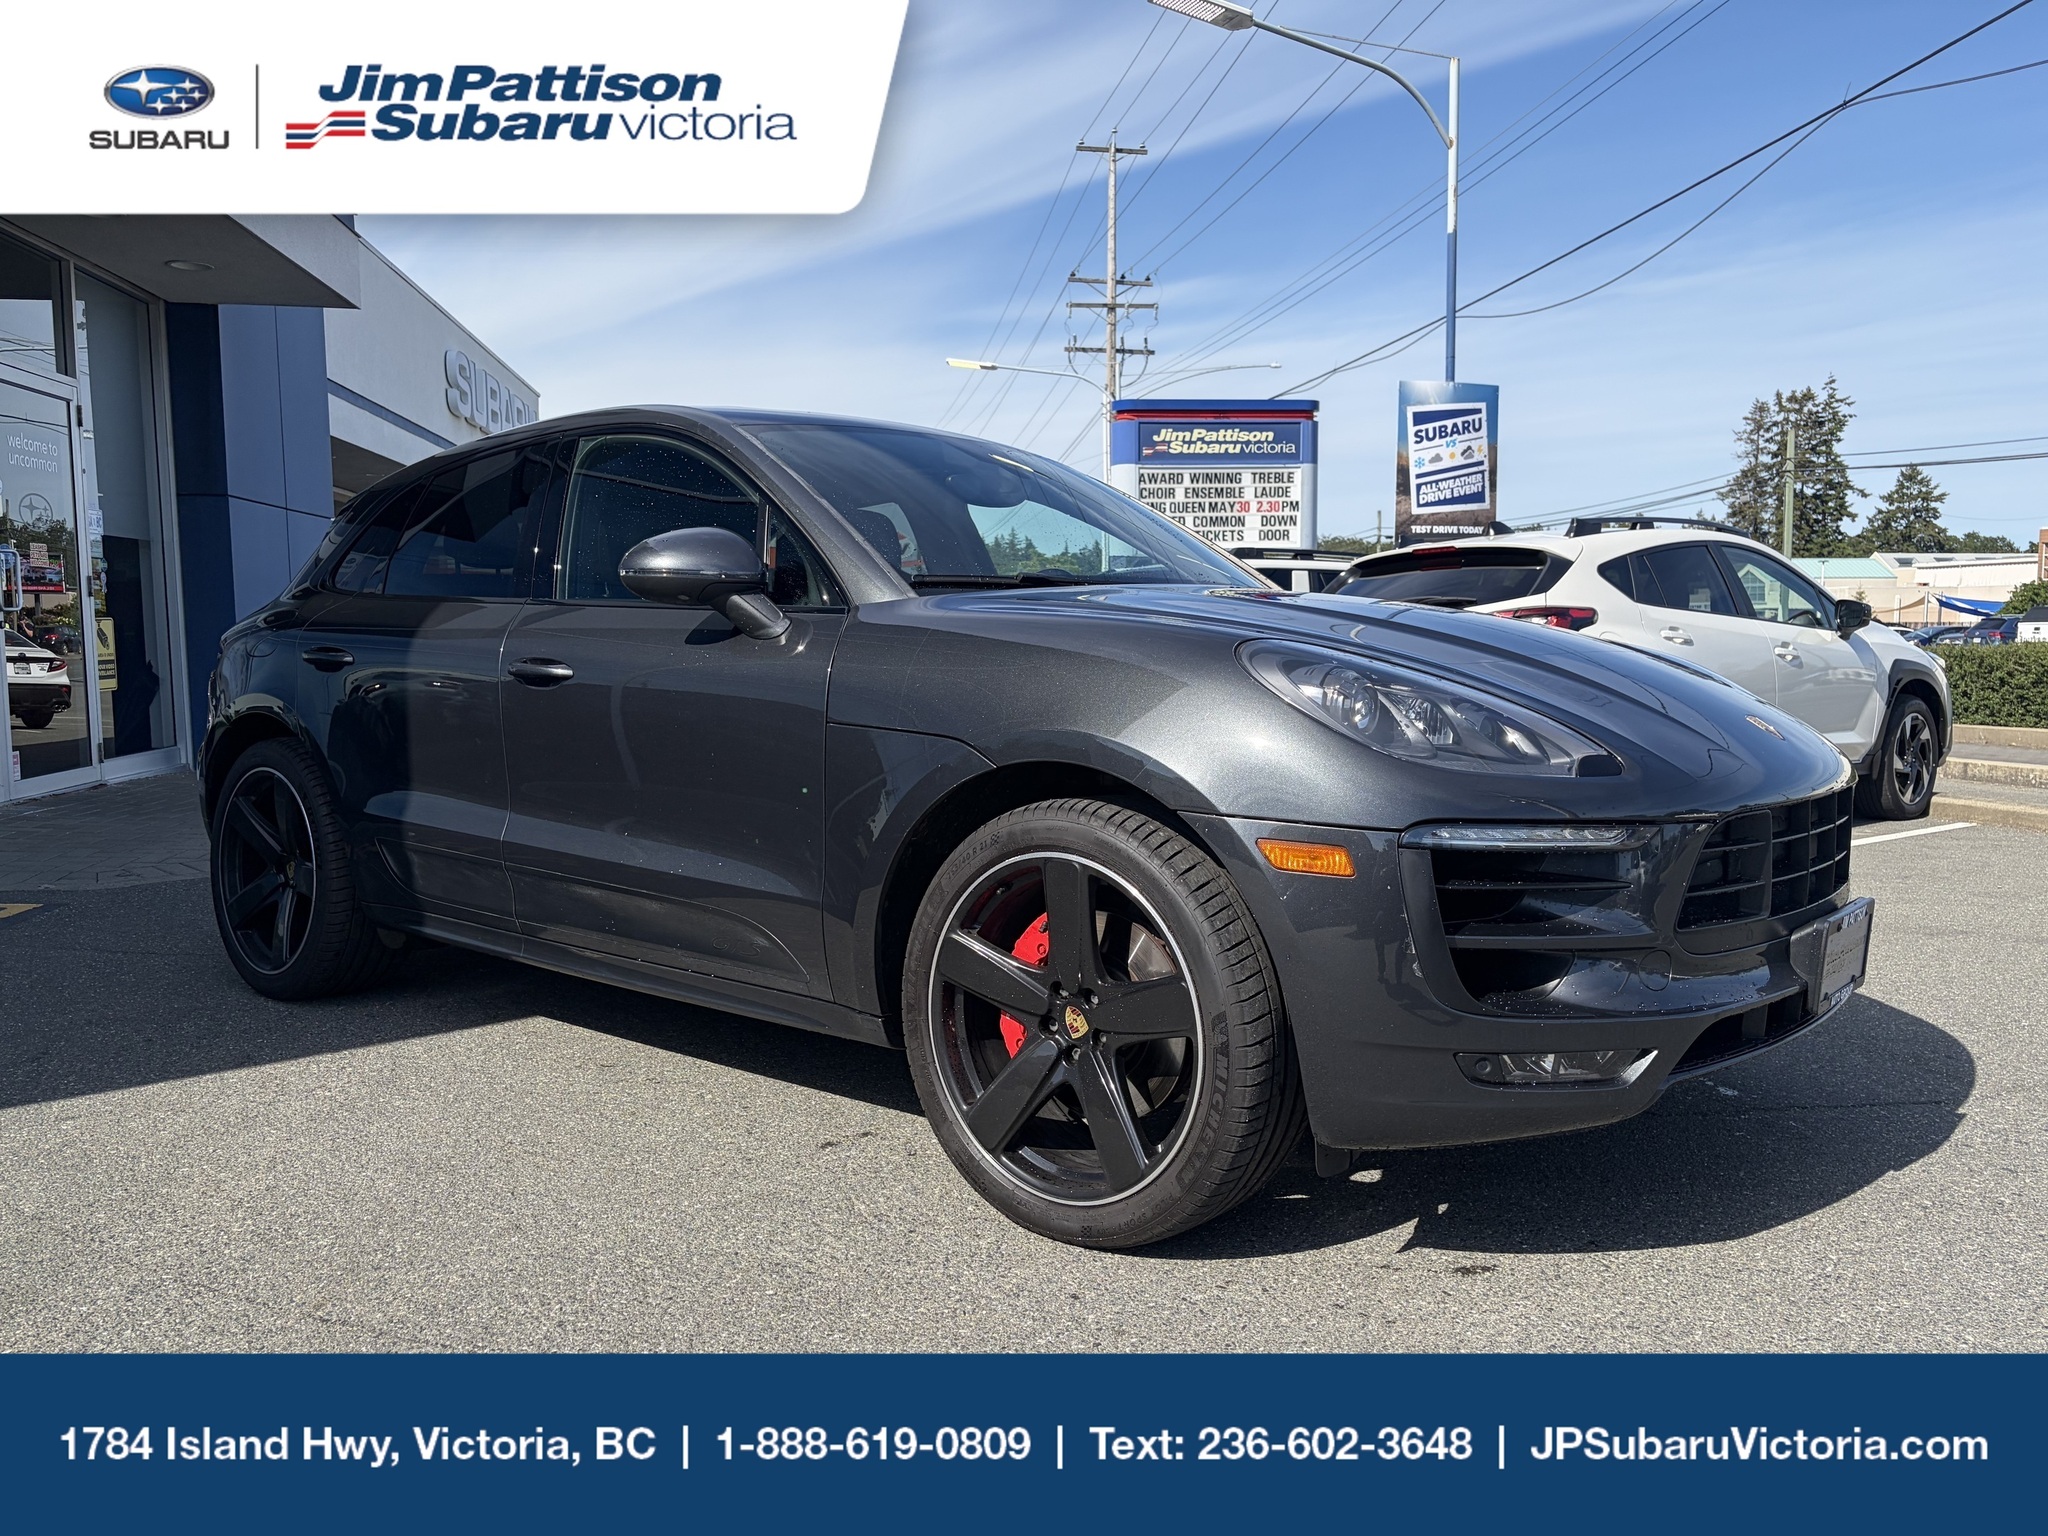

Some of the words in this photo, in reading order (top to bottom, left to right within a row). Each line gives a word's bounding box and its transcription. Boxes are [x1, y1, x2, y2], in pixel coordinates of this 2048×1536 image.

[1413, 417, 1483, 445] SUBARU
[6, 432, 48, 455] welcome
[48, 442, 58, 457] to
[1168, 441, 1243, 454] Subaru
[1243, 441, 1296, 454] victoria
[1445, 438, 1458, 449] VS
[8, 452, 58, 473] uncommon
[1139, 472, 1184, 485] AWARD
[1189, 472, 1243, 485] WINNING
[1251, 471, 1295, 484] TREBLE
[1419, 473, 1483, 495] ALL-WEATHER
[1140, 487, 1176, 499] CHOIR
[1184, 487, 1245, 499] ENSEMBLE
[1254, 486, 1292, 499] LAUDE
[1419, 488, 1452, 505] DRIVE
[1453, 482, 1484, 498] EVENT
[1169, 501, 1206, 514] QUEEN
[1193, 515, 1246, 528] COMMON
[1261, 515, 1297, 527] DOWN
[1259, 529, 1290, 541] DOOR
[1411, 525, 1432, 534] TEST
[1433, 525, 1458, 534] DRIVE
[1459, 526, 1485, 535] TODAY
